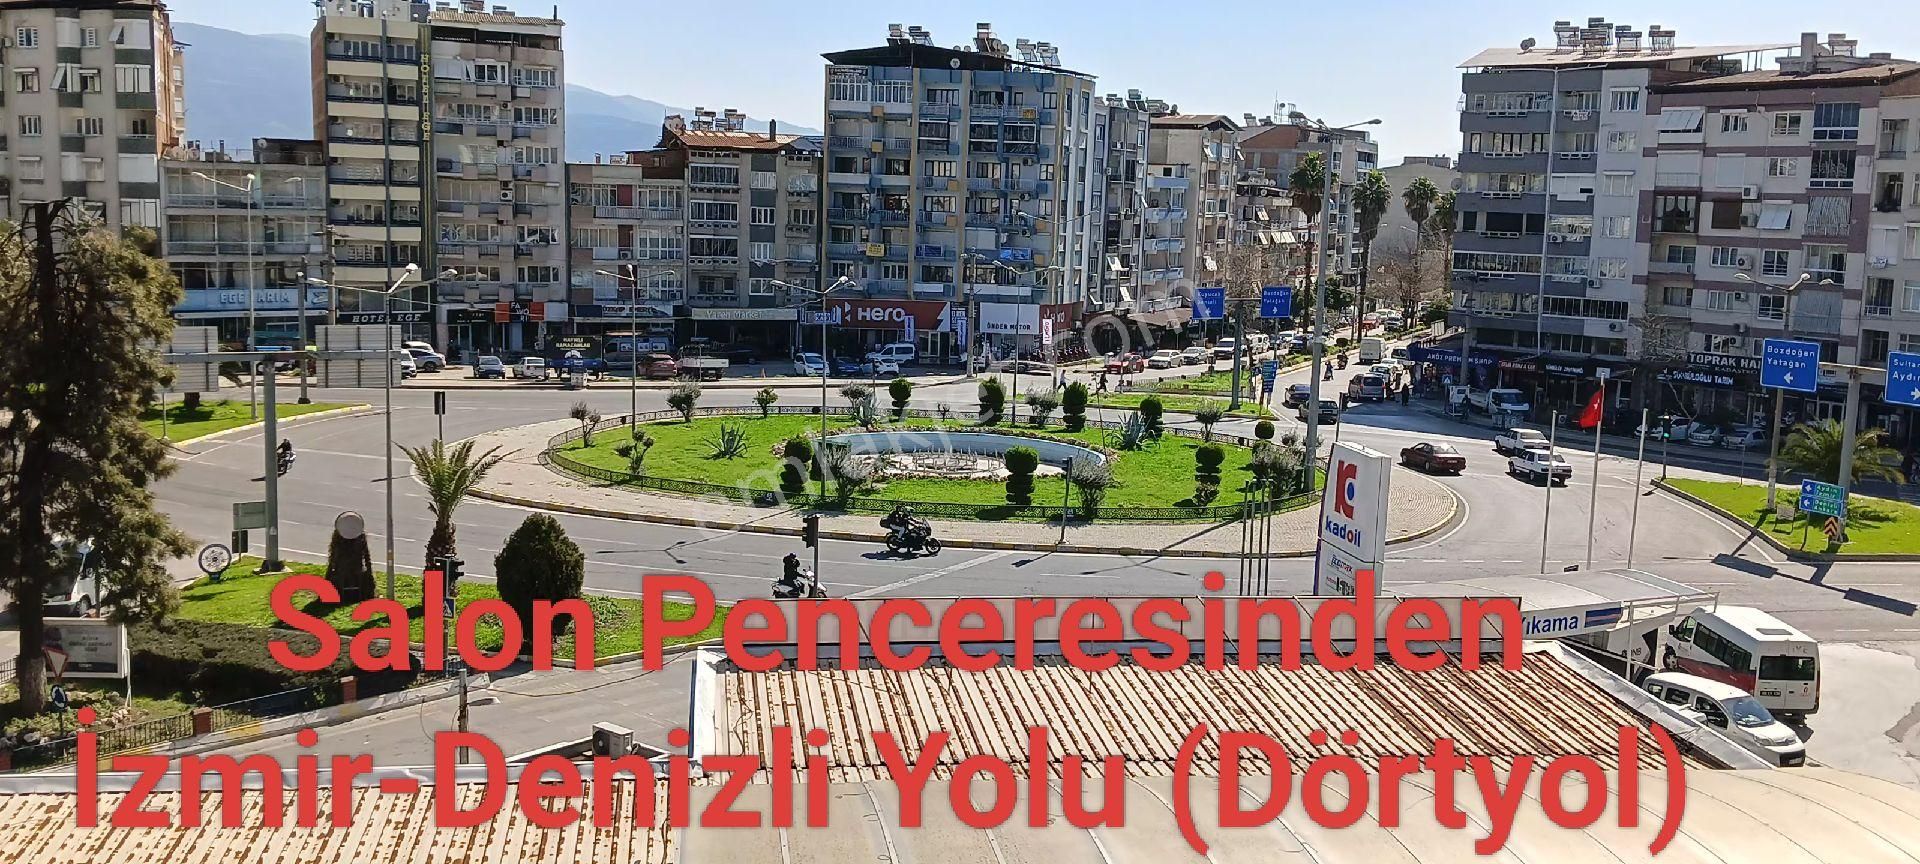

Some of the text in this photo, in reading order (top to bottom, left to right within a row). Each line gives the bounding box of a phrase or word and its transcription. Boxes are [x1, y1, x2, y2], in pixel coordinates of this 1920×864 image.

[1766, 345, 1815, 358] Bozdoğan
[1689, 353, 1737, 367] TOPRAK
[1767, 357, 1806, 369] Yatağan
[1325, 515, 1361, 548] kadoil
